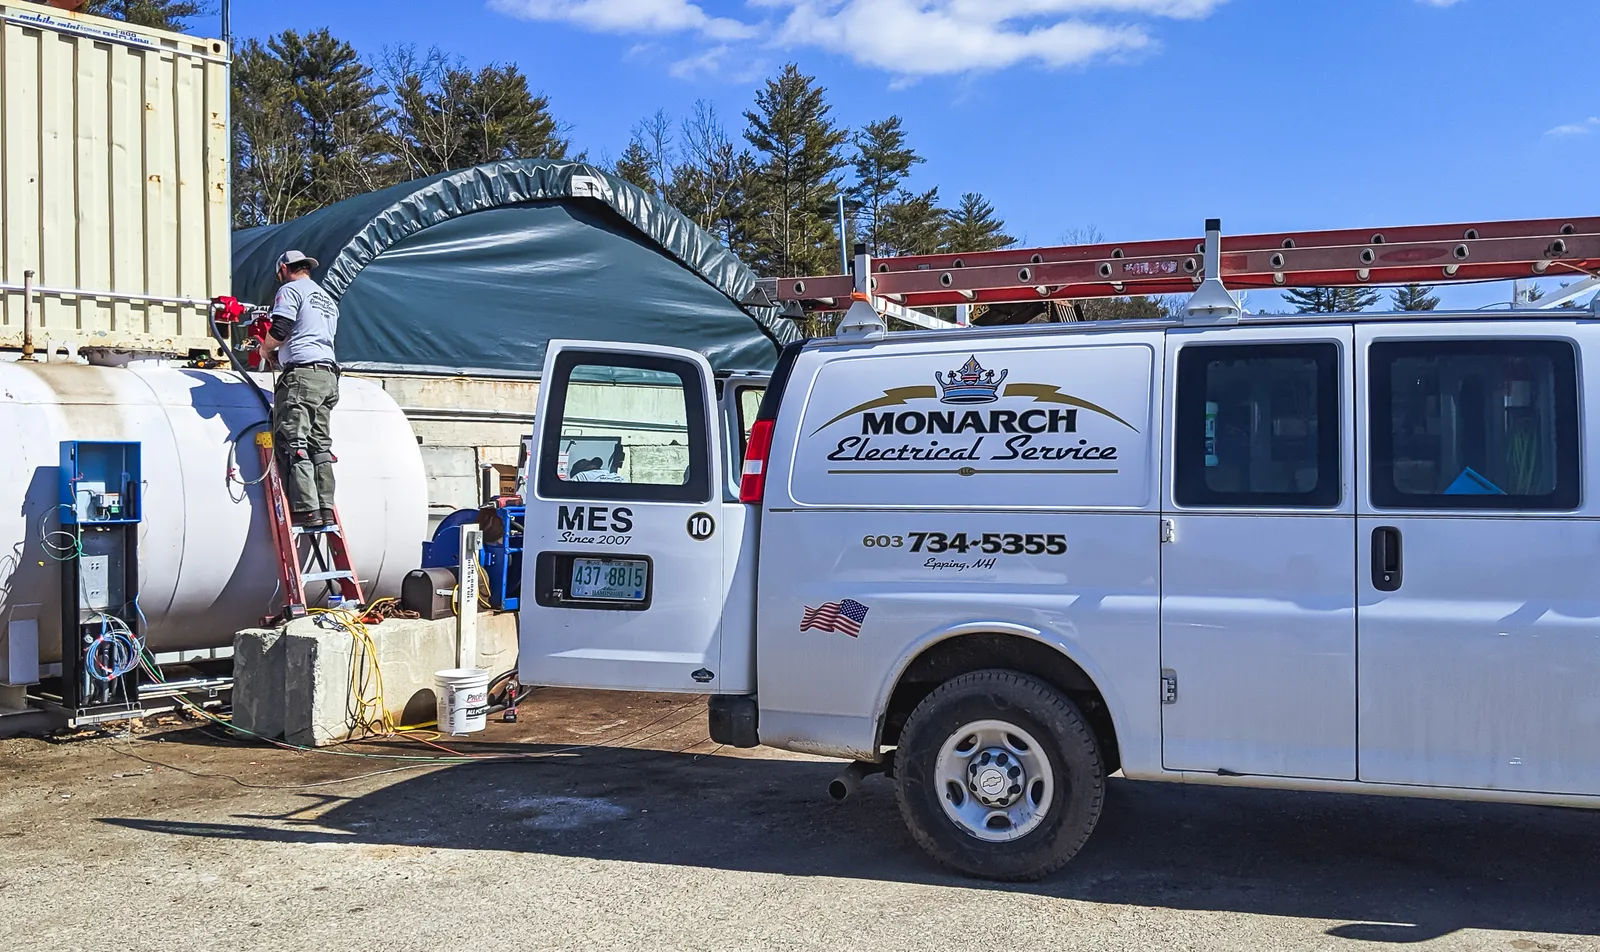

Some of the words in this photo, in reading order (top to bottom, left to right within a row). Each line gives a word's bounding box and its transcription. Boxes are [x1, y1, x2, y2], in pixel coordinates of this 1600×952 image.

[861, 408, 1078, 435] MONARCH
[827, 436, 984, 461] Electrical
[990, 434, 1118, 460] Service
[557, 505, 633, 533] MES
[691, 517, 711, 535] 10
[557, 531, 595, 544] Since
[596, 534, 632, 545] 2007
[862, 535, 904, 548] 603
[971, 558, 997, 570] NH
[575, 565, 601, 586] 437
[608, 567, 643, 588] 8815
